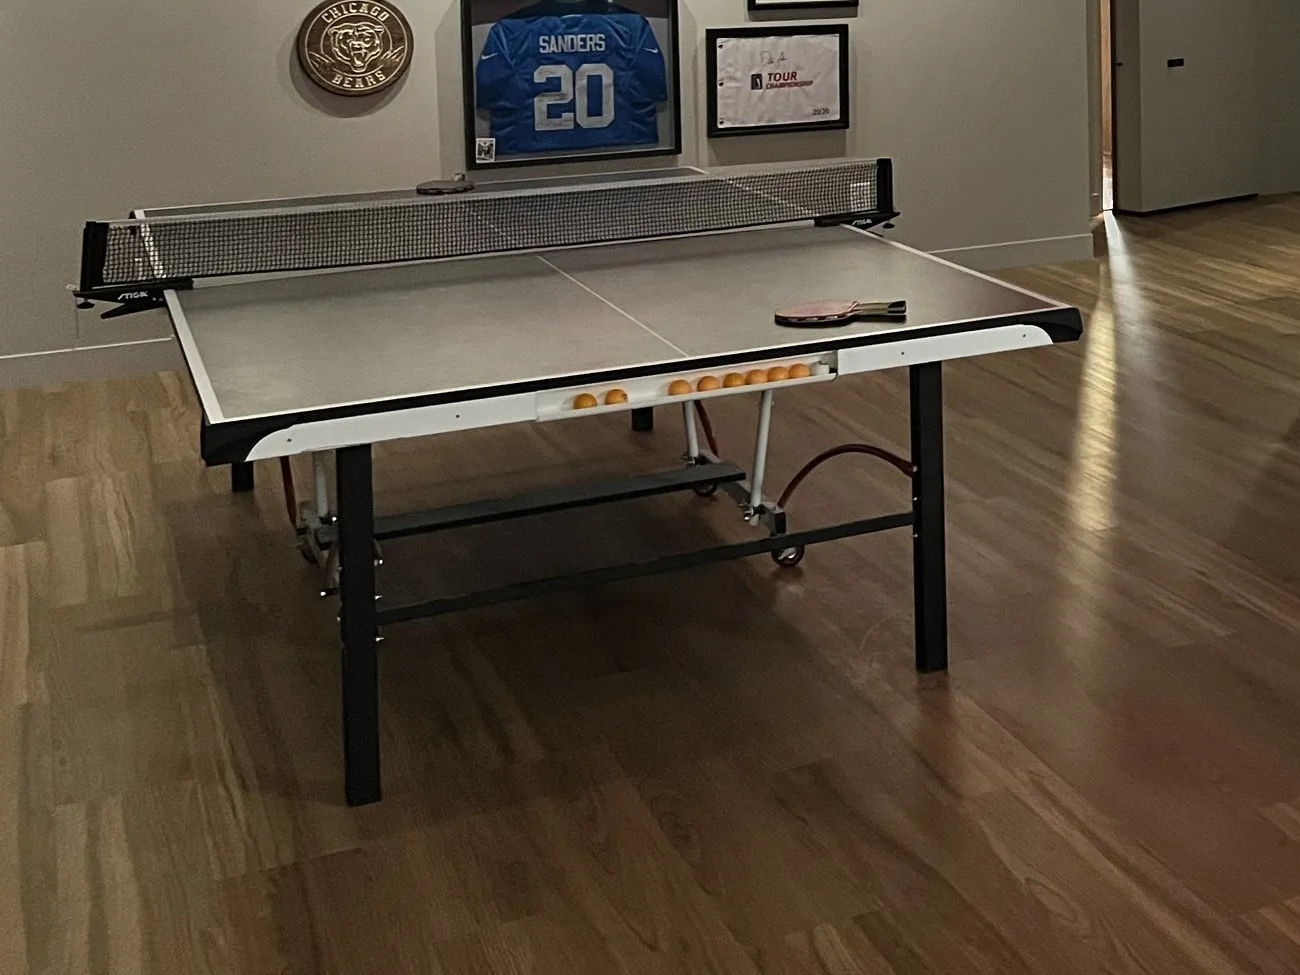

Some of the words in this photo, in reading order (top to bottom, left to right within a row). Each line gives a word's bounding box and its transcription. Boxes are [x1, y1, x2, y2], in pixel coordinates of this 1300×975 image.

[321, 2, 390, 23] CHICAGO
[539, 33, 606, 54] SANDERS
[332, 70, 386, 88] BEARS
[765, 80, 813, 90] CHAMPIONSHIP
[767, 71, 798, 82] TOUR
[533, 63, 615, 131] 20
[117, 291, 148, 300] STIGA
